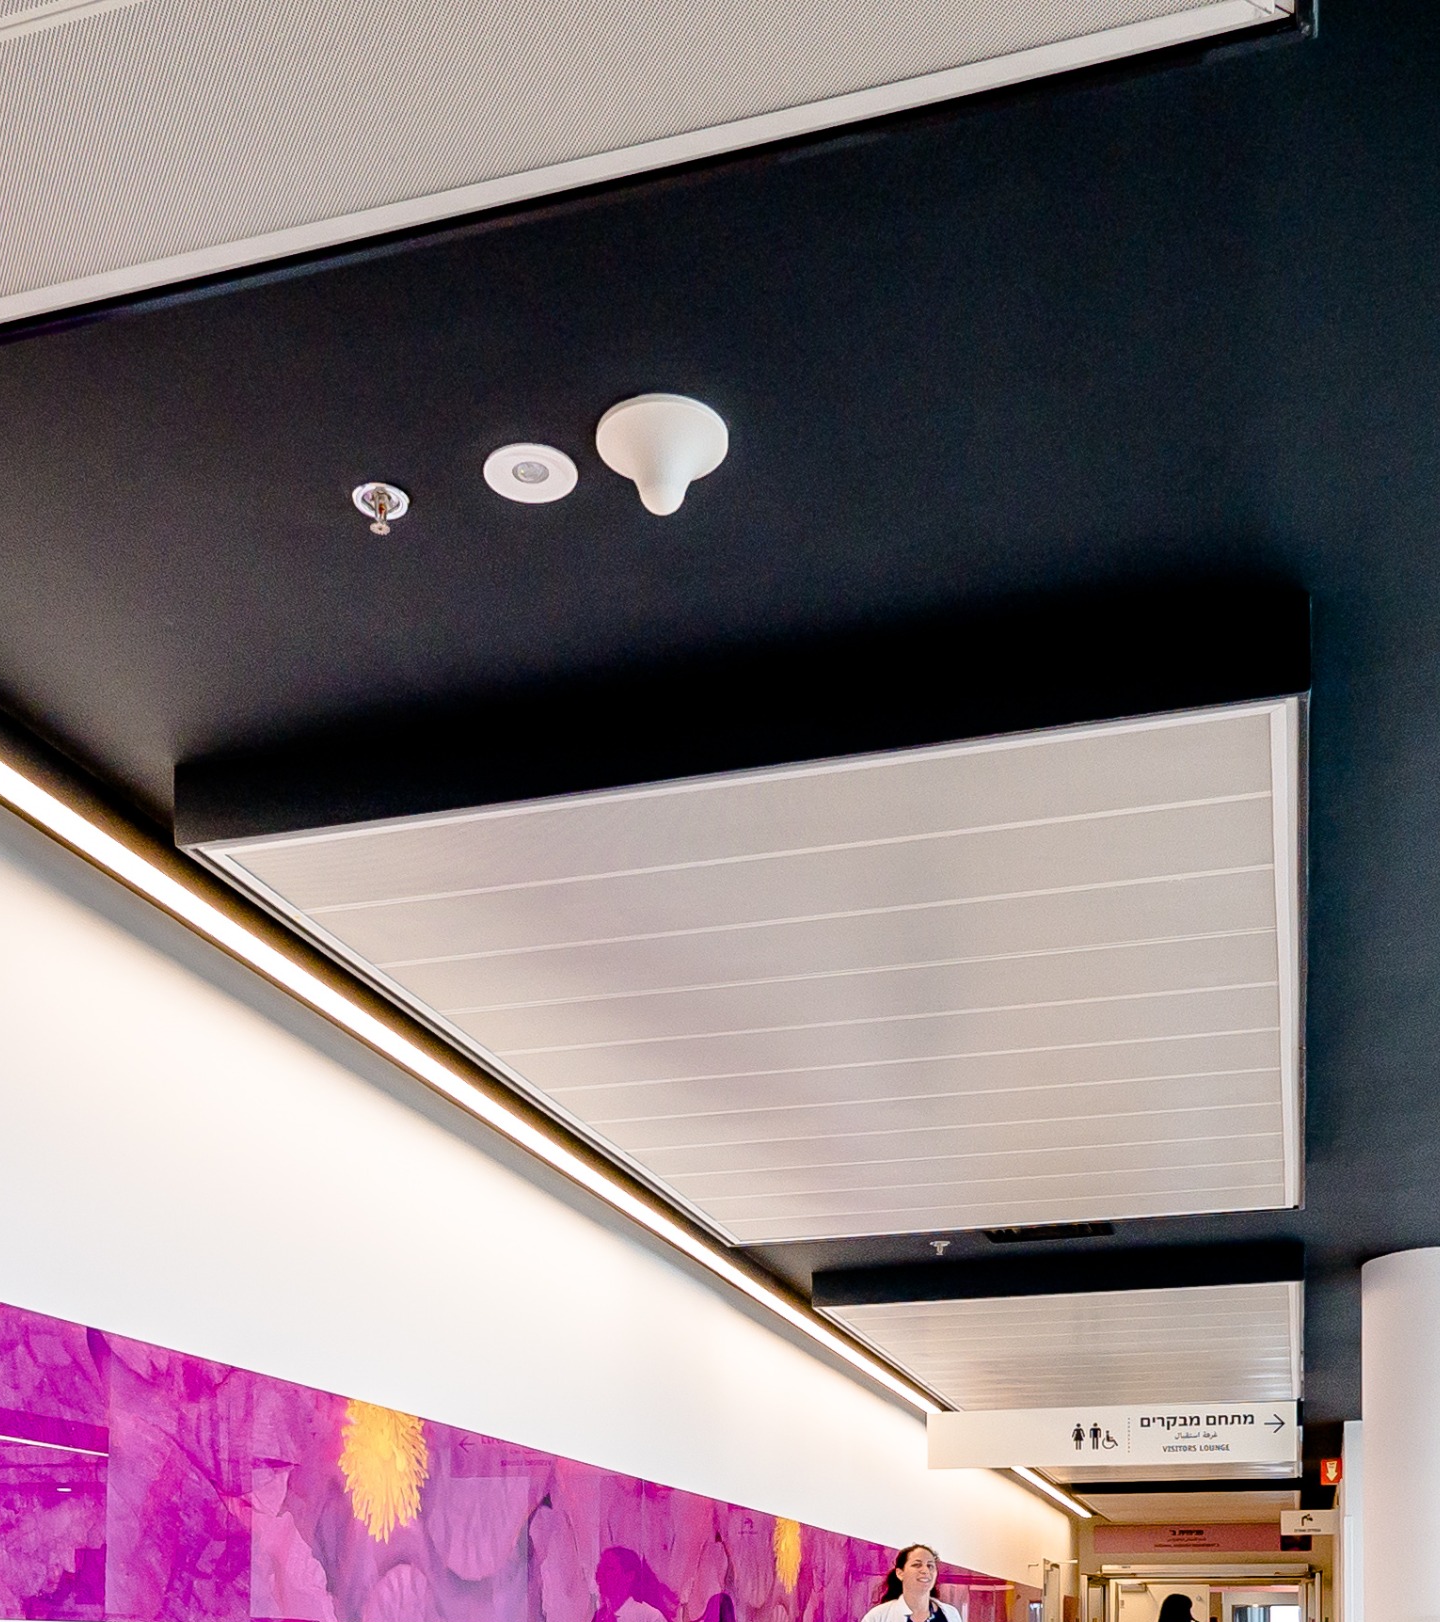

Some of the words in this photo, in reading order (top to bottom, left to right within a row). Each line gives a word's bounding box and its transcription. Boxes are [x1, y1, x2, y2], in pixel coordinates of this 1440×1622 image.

[1139, 1415, 1201, 1430] מבקרים
[1205, 1413, 1255, 1426] מתחם
[1162, 1444, 1197, 1453] VISITORS
[1199, 1443, 1230, 1452] LOUNGE
